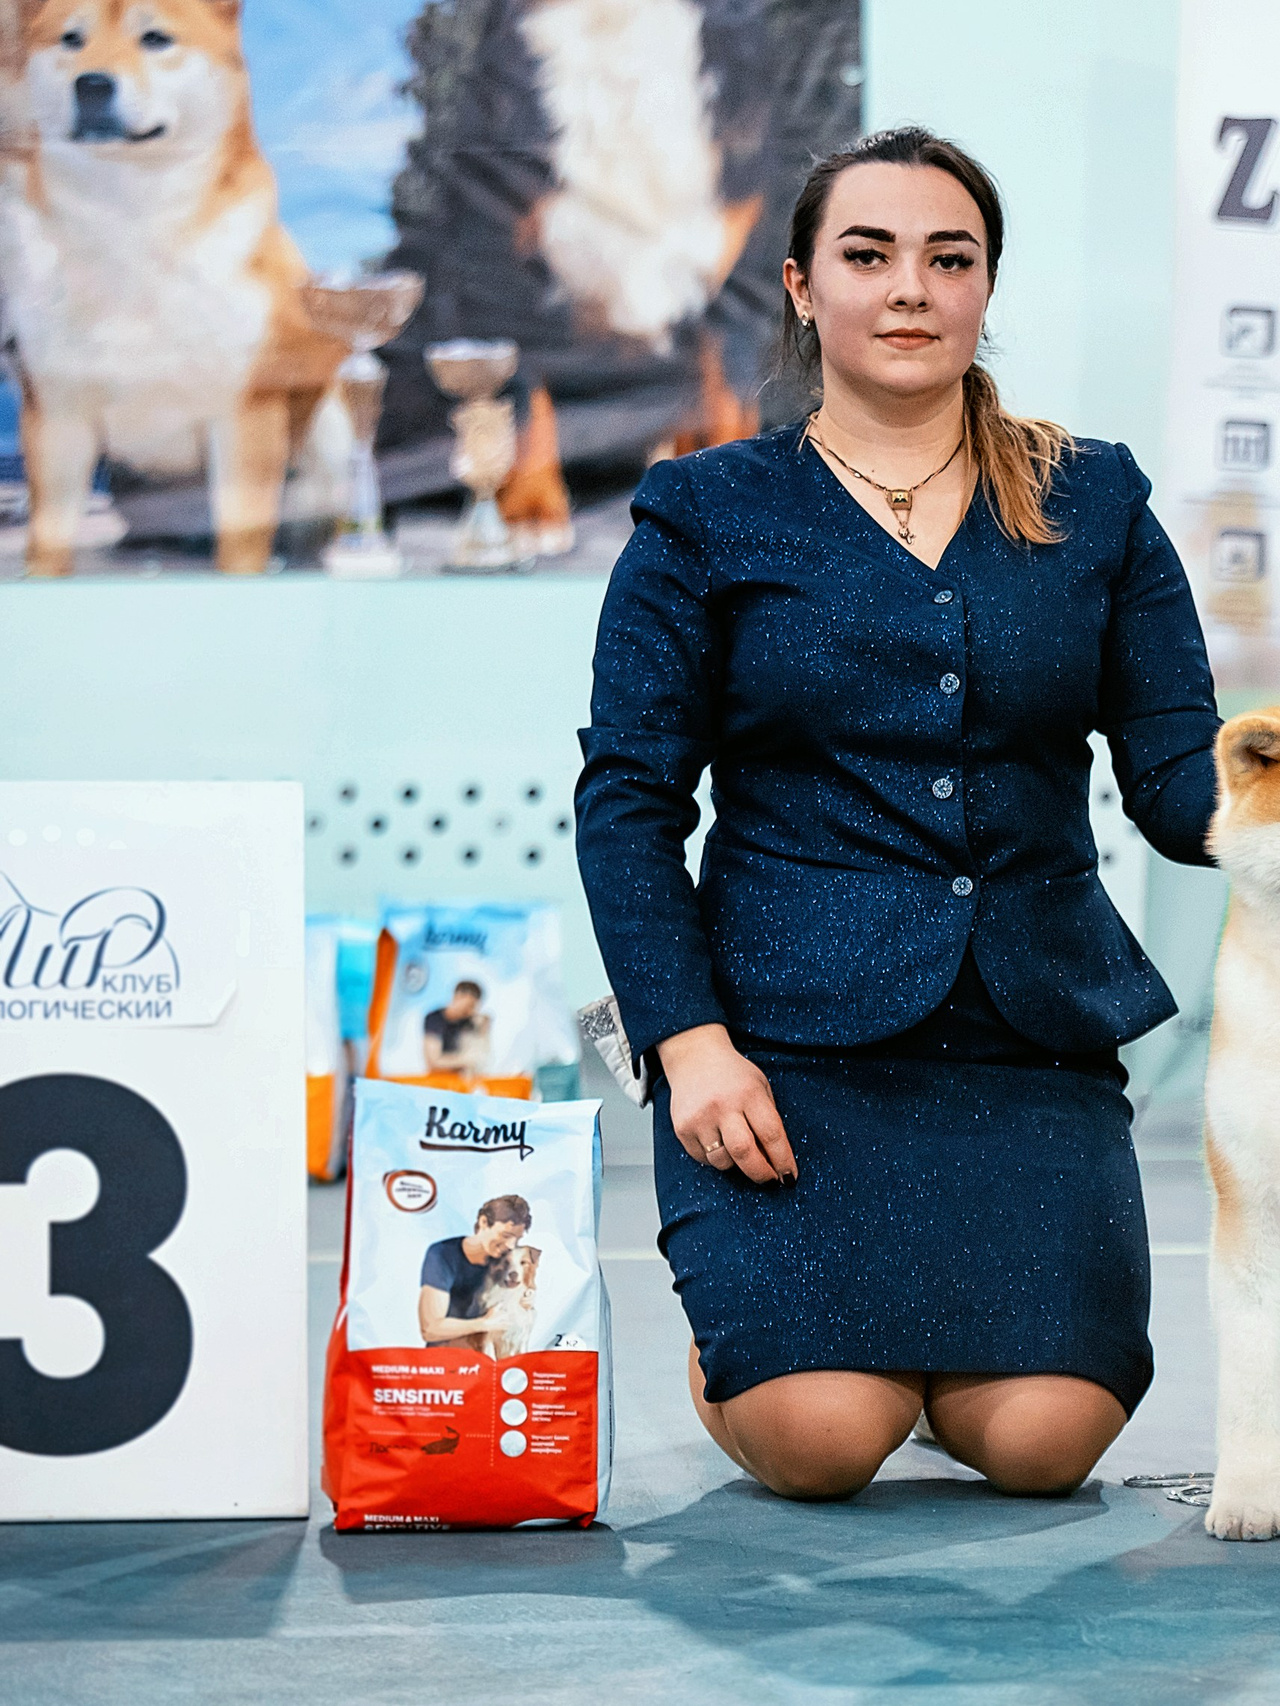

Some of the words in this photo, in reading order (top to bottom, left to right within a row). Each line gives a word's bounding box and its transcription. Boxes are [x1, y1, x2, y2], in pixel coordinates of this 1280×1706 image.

[102, 974, 172, 994] КЛУБ
[420, 1105, 534, 1161] Karmy
[0, 1072, 193, 1457] 3
[371, 1365, 410, 1374] MEDIUM
[419, 1366, 445, 1375] MAXI
[373, 1388, 465, 1406] SENSITIVE
[364, 1513, 404, 1522] MEDIUM
[413, 1515, 439, 1523] MAXI
